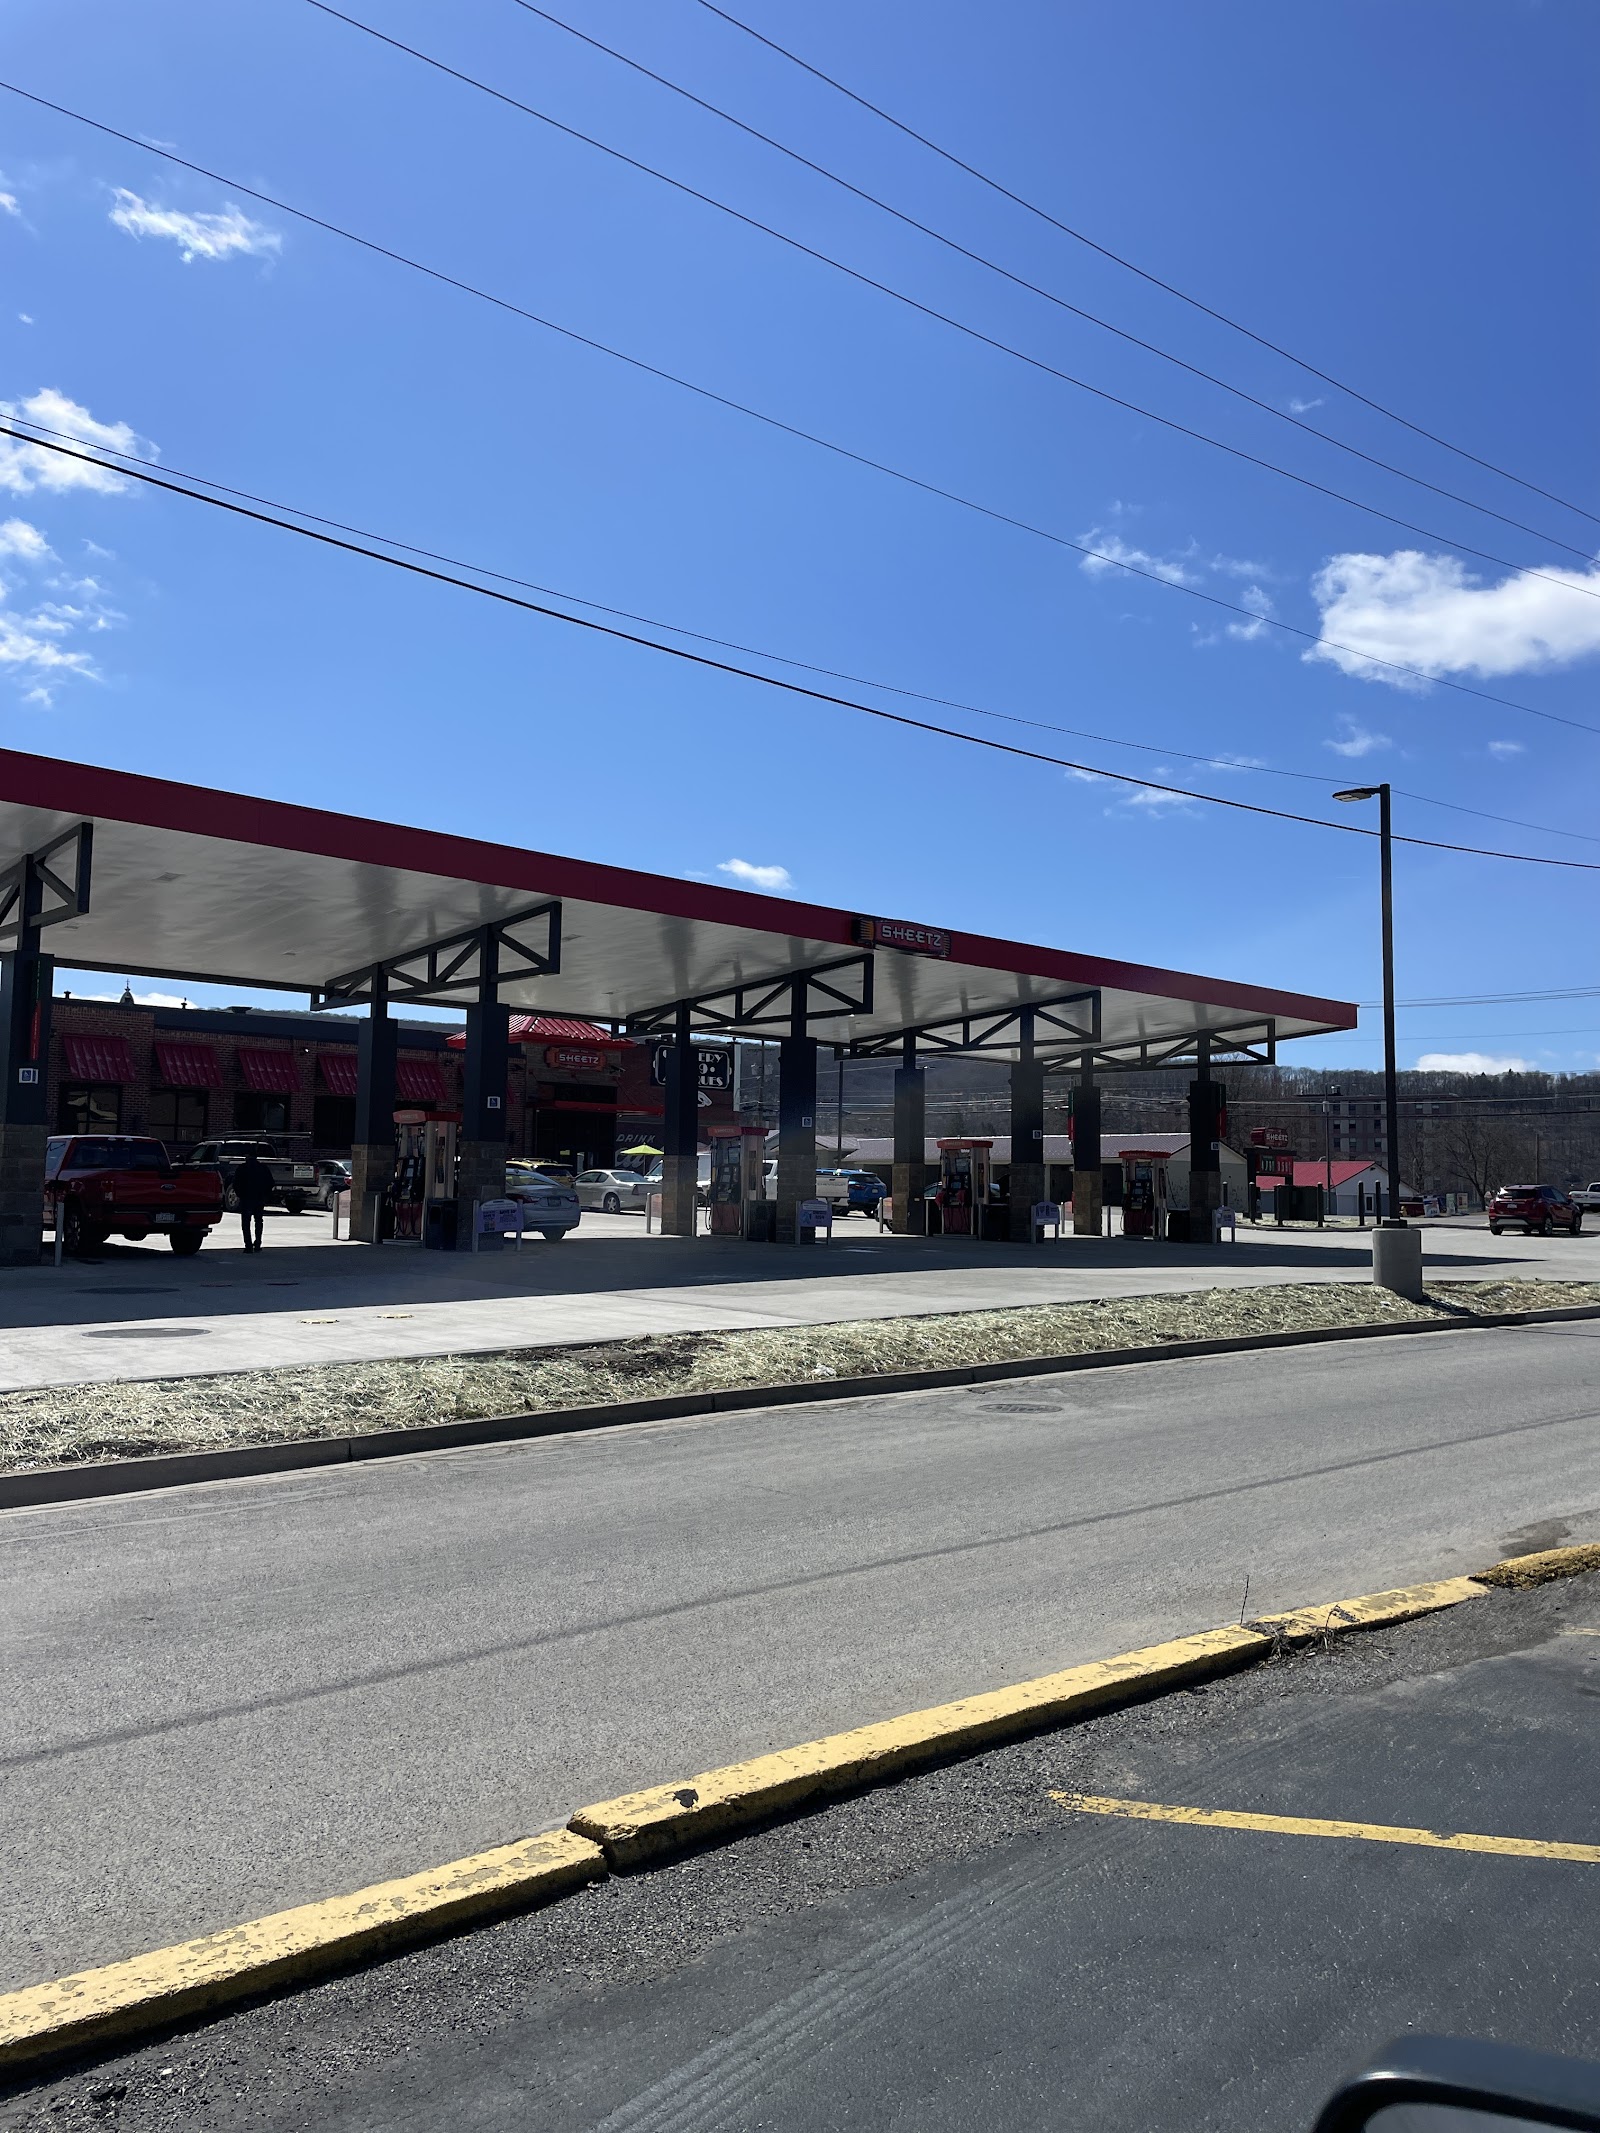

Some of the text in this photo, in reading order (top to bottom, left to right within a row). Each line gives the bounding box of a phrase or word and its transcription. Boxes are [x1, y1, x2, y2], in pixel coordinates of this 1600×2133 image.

[882, 925, 941, 946] SHEETZ
[559, 1053, 599, 1065] SHEETZ
[615, 1133, 656, 1143] DRINK
[1266, 1133, 1288, 1142] SHEETZ
